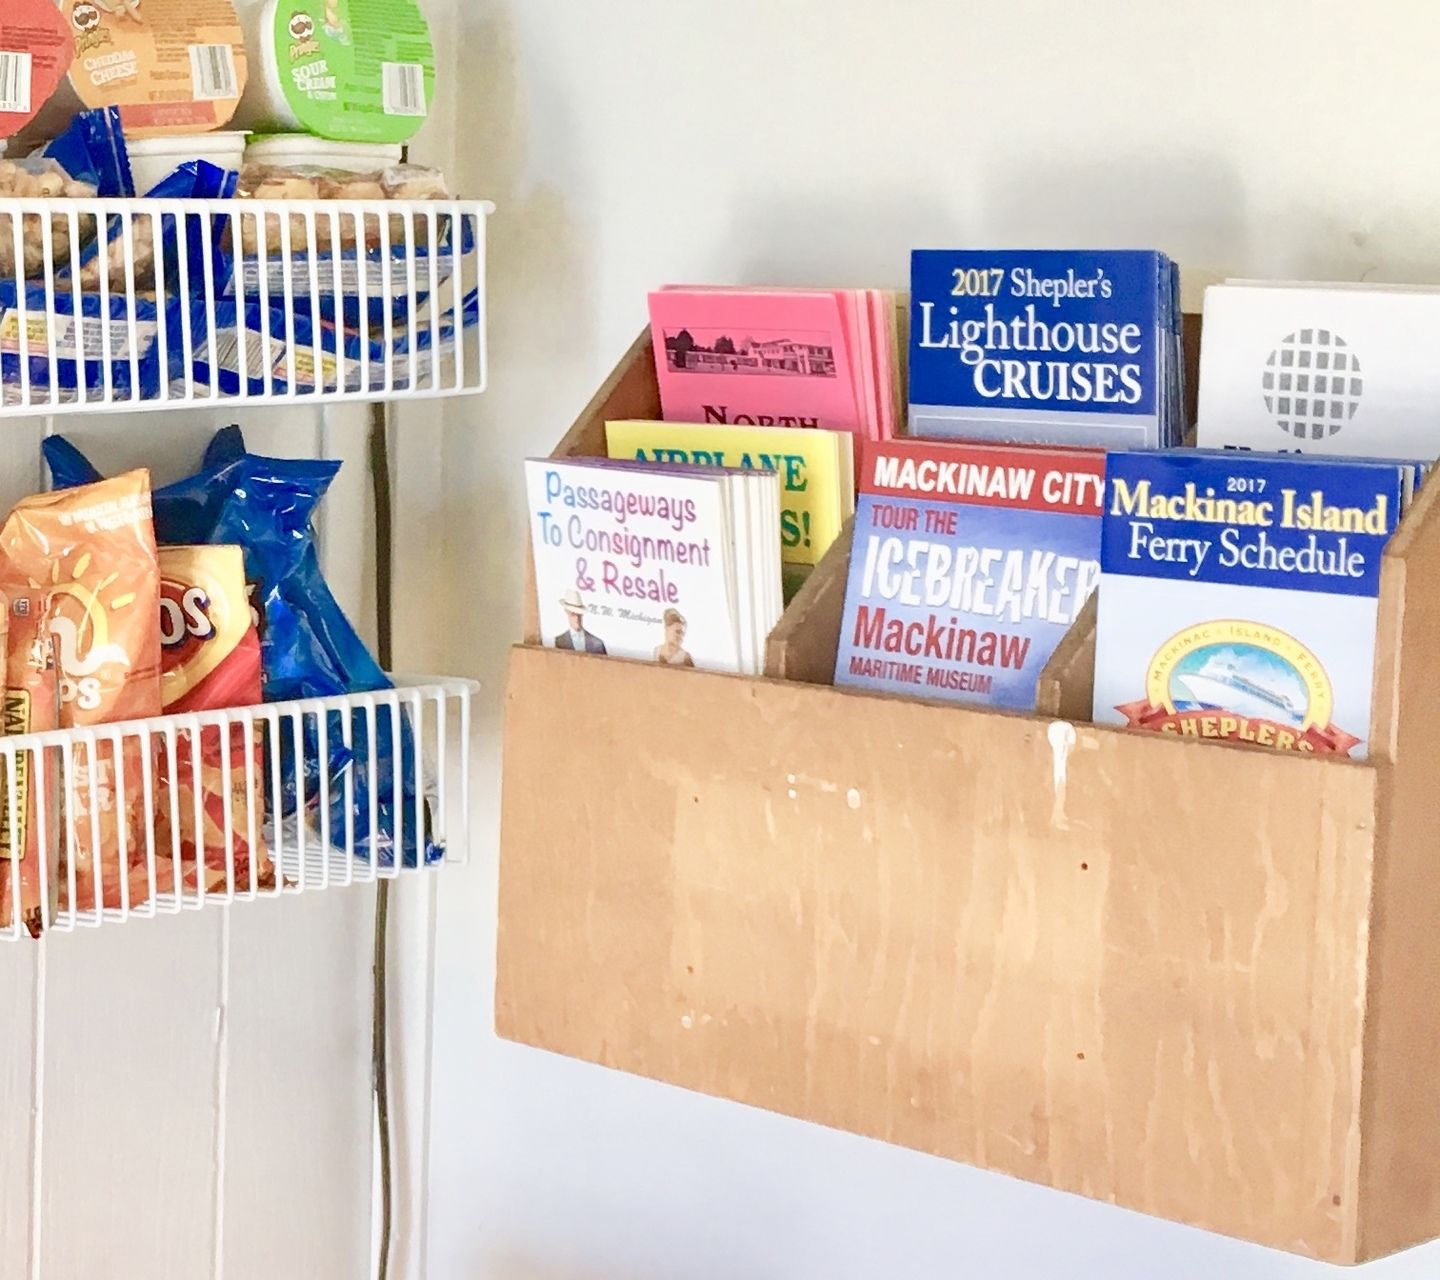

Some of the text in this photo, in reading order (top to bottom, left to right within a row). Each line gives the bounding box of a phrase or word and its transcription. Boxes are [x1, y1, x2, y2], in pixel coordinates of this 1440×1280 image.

[89, 60, 140, 87] CHEESE
[290, 58, 329, 83] SOUR
[950, 266, 1113, 308] 2017 Shepler's
[917, 300, 1143, 366] Lighthouse
[972, 357, 1143, 406] CRUISES
[545, 469, 698, 532] Passageways
[873, 454, 1106, 508] MACKINAW CITY
[1110, 477, 1389, 536] Mackinac Island
[1225, 476, 1267, 495] 2017
[536, 510, 713, 569] To Consignment
[870, 503, 959, 537] TOUR THE
[1127, 520, 1367, 578] Ferry Schedule
[575, 556, 681, 605] & Resale
[852, 604, 1033, 671] Mackinaw
[1152, 624, 1327, 701] MACKINAC ISLAND FERRY
[848, 655, 994, 696] MARITIME MUSEUM
